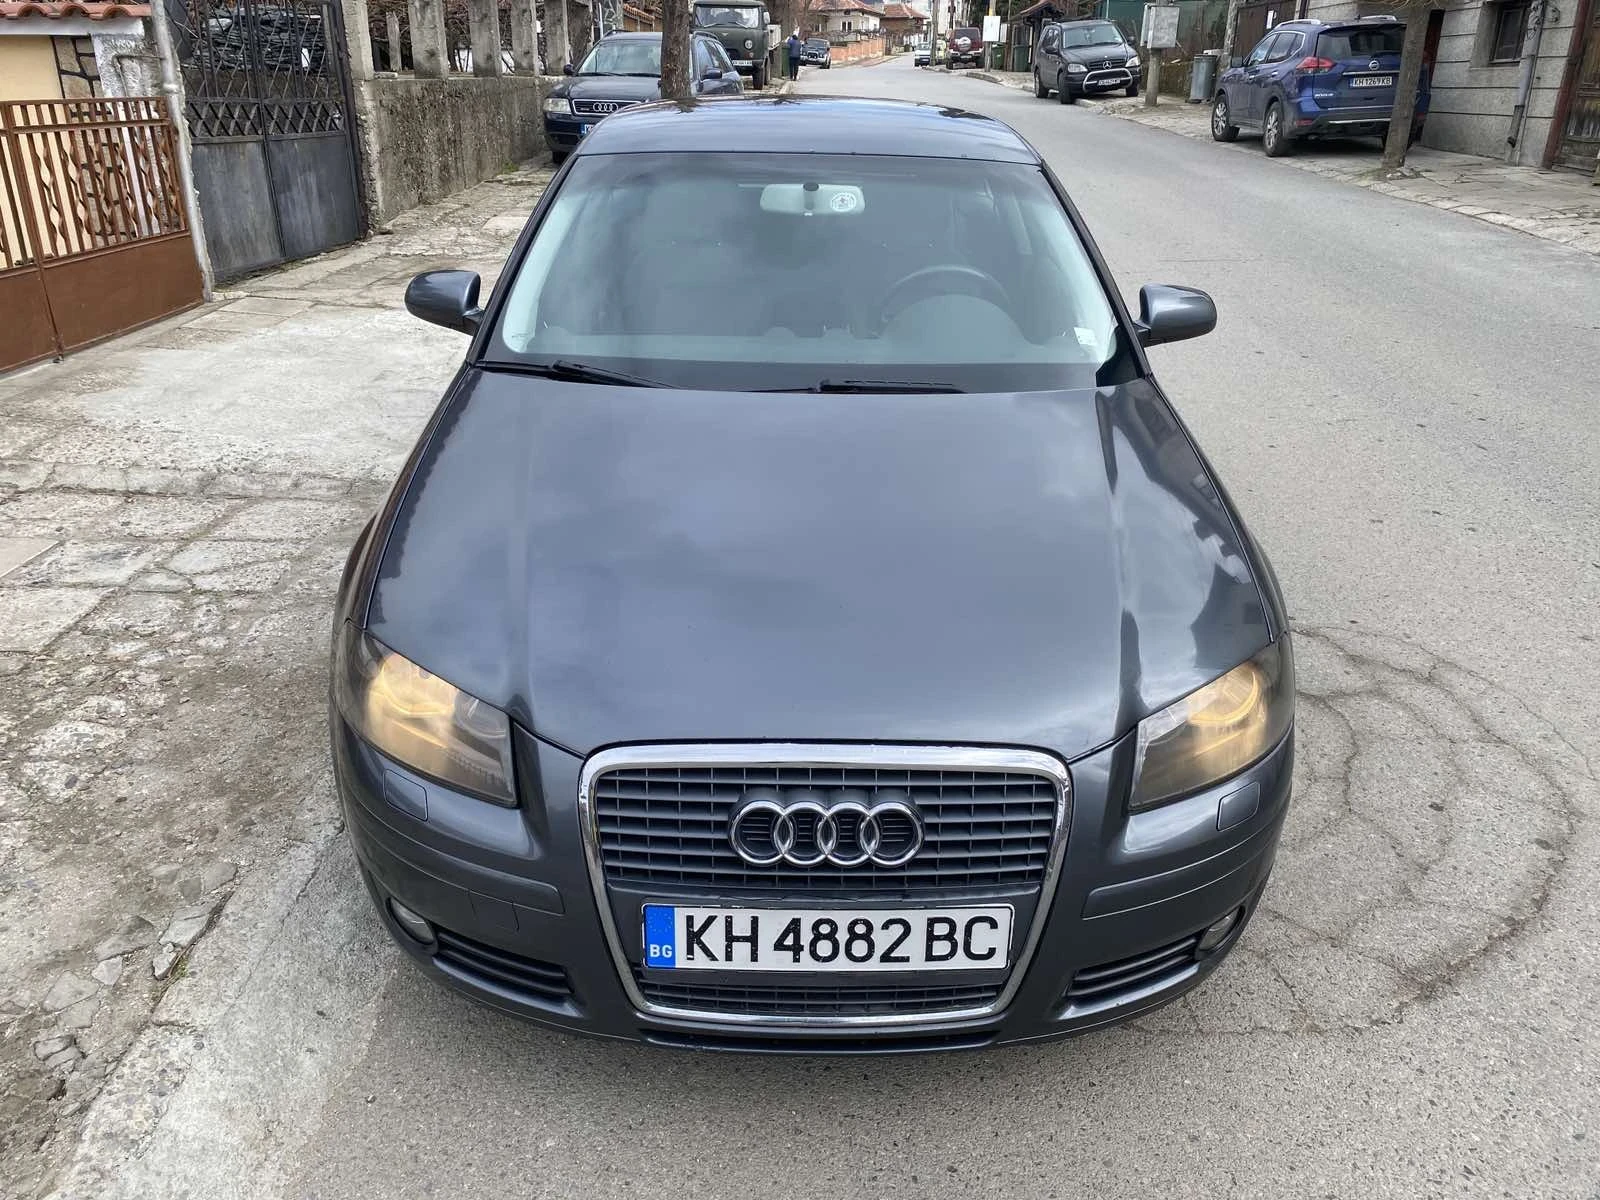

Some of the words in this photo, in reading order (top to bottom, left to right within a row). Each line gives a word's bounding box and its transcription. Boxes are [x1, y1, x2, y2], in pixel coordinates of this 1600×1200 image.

[649, 944, 673, 958] BG
[685, 915, 759, 962] KH
[773, 917, 911, 963] 4882
[924, 915, 998, 962] BC
